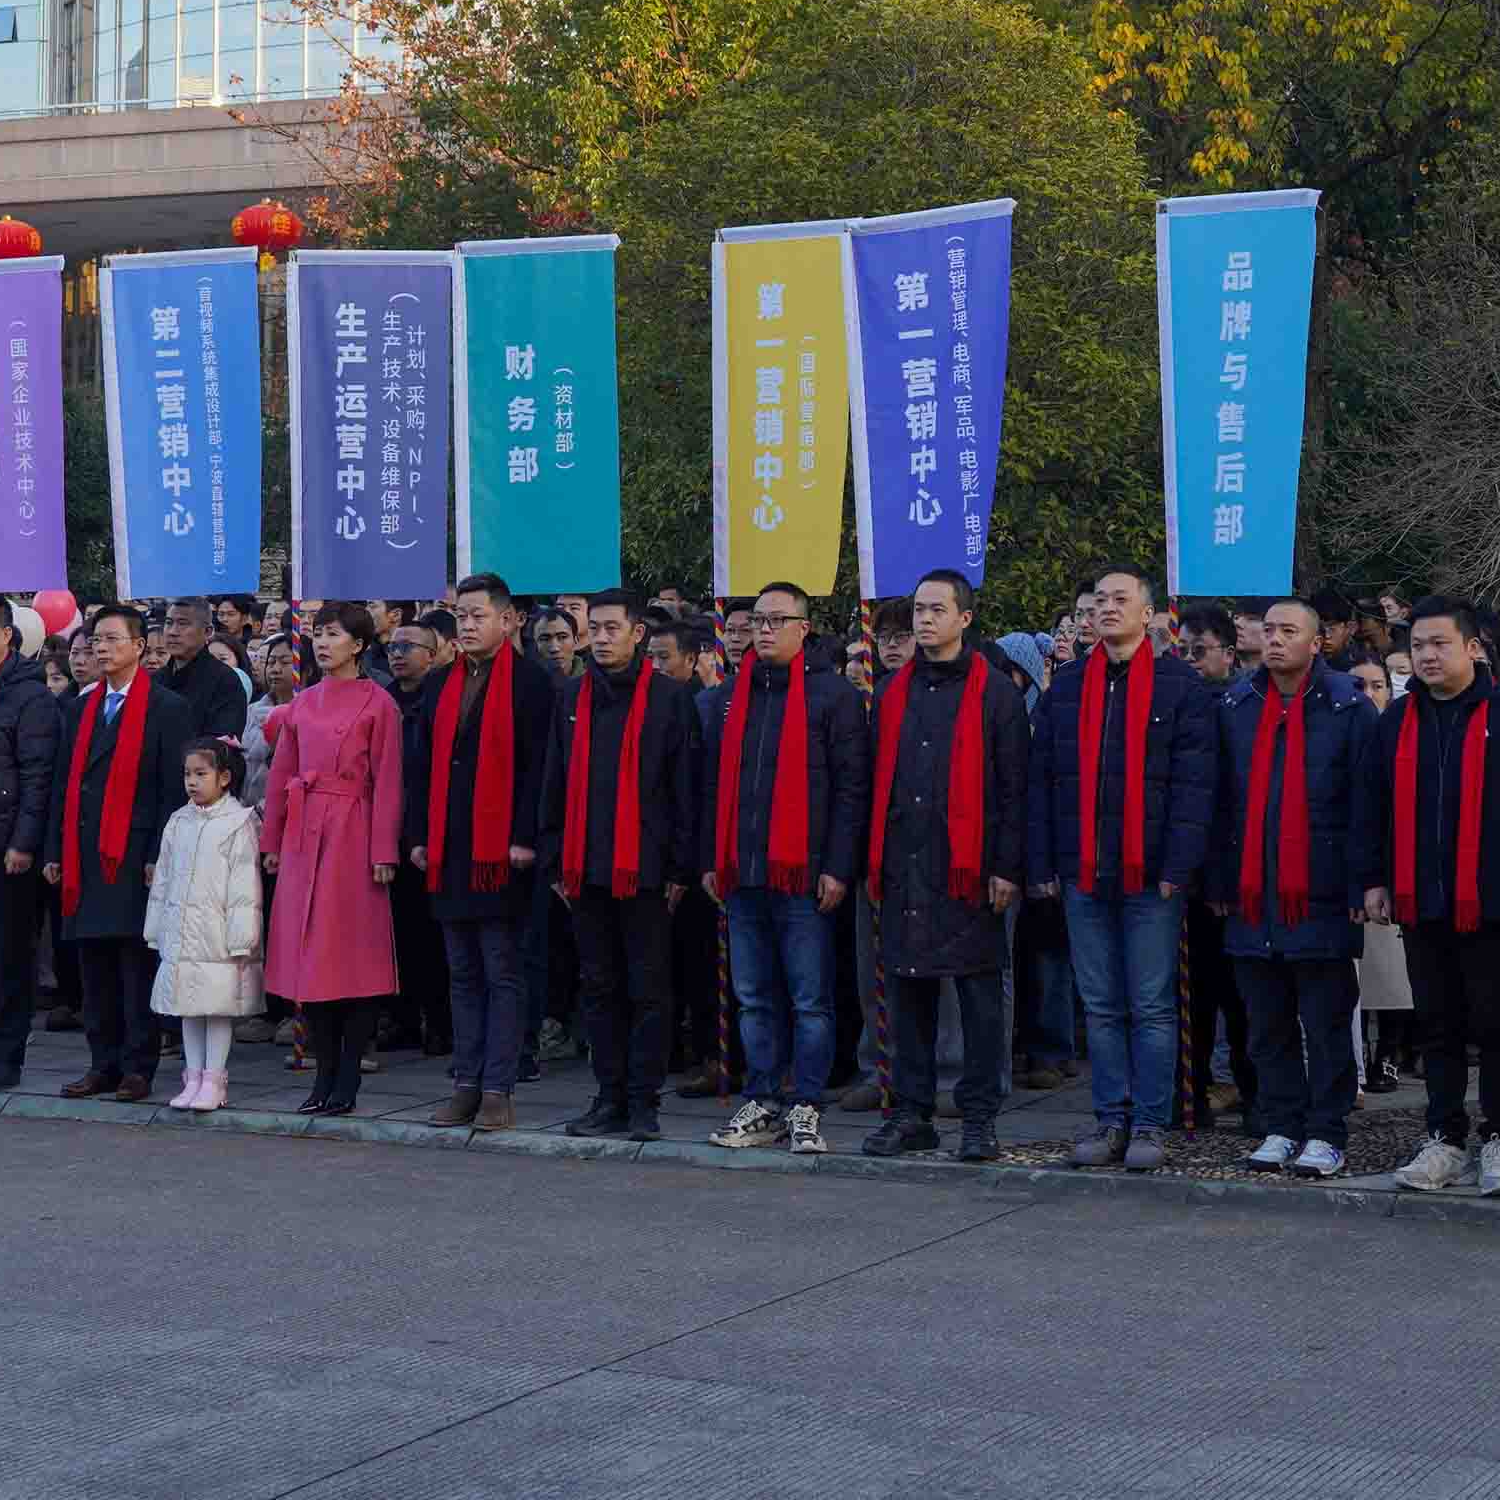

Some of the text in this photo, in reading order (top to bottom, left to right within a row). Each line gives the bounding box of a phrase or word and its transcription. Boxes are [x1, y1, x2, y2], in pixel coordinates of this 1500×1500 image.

[150, 305, 194, 537] 第二营销中心
[335, 303, 367, 540] 生产运营中心
[504, 344, 538, 483] 财务部
[751, 283, 785, 532] 第一营销中心
[894, 272, 942, 527] 第一营销中心
[1212, 251, 1253, 545] 品牌与售后部
